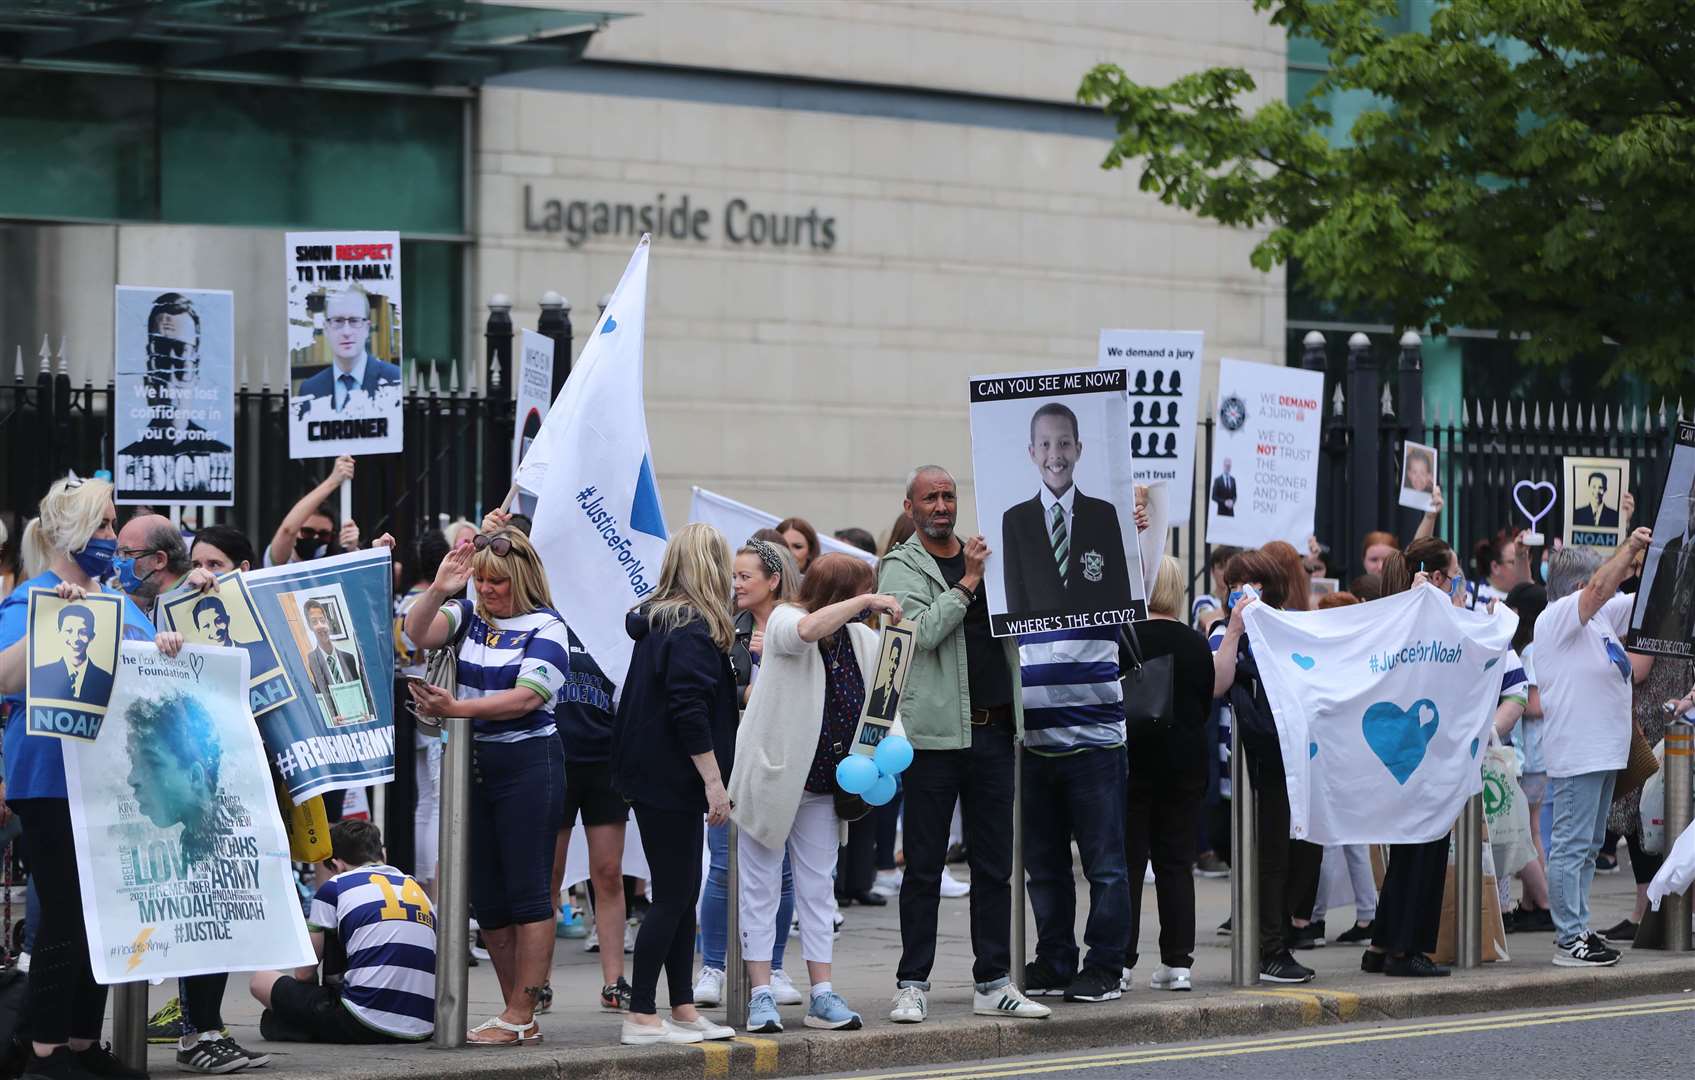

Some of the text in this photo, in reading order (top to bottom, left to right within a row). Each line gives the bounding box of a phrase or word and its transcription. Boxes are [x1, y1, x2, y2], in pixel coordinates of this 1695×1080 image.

[523, 184, 836, 249] Laganside Courts
[296, 243, 393, 261] SHOW RESPECT
[296, 266, 314, 281] TO
[316, 265, 342, 280] THE
[1107, 347, 1195, 360] We demand a jury
[133, 385, 218, 400] We have lost
[978, 372, 1120, 396] CAN YOU SEE ME NOW?
[1260, 392, 1317, 409] WE DEMAND
[130, 405, 221, 420] confidence in
[1260, 407, 1266, 416] A
[138, 427, 217, 442] you Coroner
[308, 417, 388, 441] CORONER
[1258, 430, 1295, 444] WE DO
[1257, 444, 1312, 461] NOT TRUST
[1256, 458, 1276, 471] THE
[1133, 470, 1176, 479] on't trust
[1254, 472, 1307, 489] CORONER
[1253, 487, 1300, 503] AND THE
[1574, 532, 1616, 546] NOAH
[1006, 608, 1135, 634] WHERE'S THE CCTV??
[120, 654, 137, 665] he
[138, 666, 190, 680] Foundation
[251, 679, 288, 711] AH
[557, 682, 609, 711] HOENIX
[34, 710, 101, 738] NOAH
[276, 725, 395, 780] #REMEMBERMY
[215, 836, 259, 858] NOAHS
[211, 859, 260, 890] ARMY
[149, 880, 211, 899] #REMEMBER
[368, 873, 430, 919] 14
[138, 894, 214, 924] MYNOAH
[213, 901, 265, 921] FORNOAH
[174, 920, 233, 944] #JUSTICE
